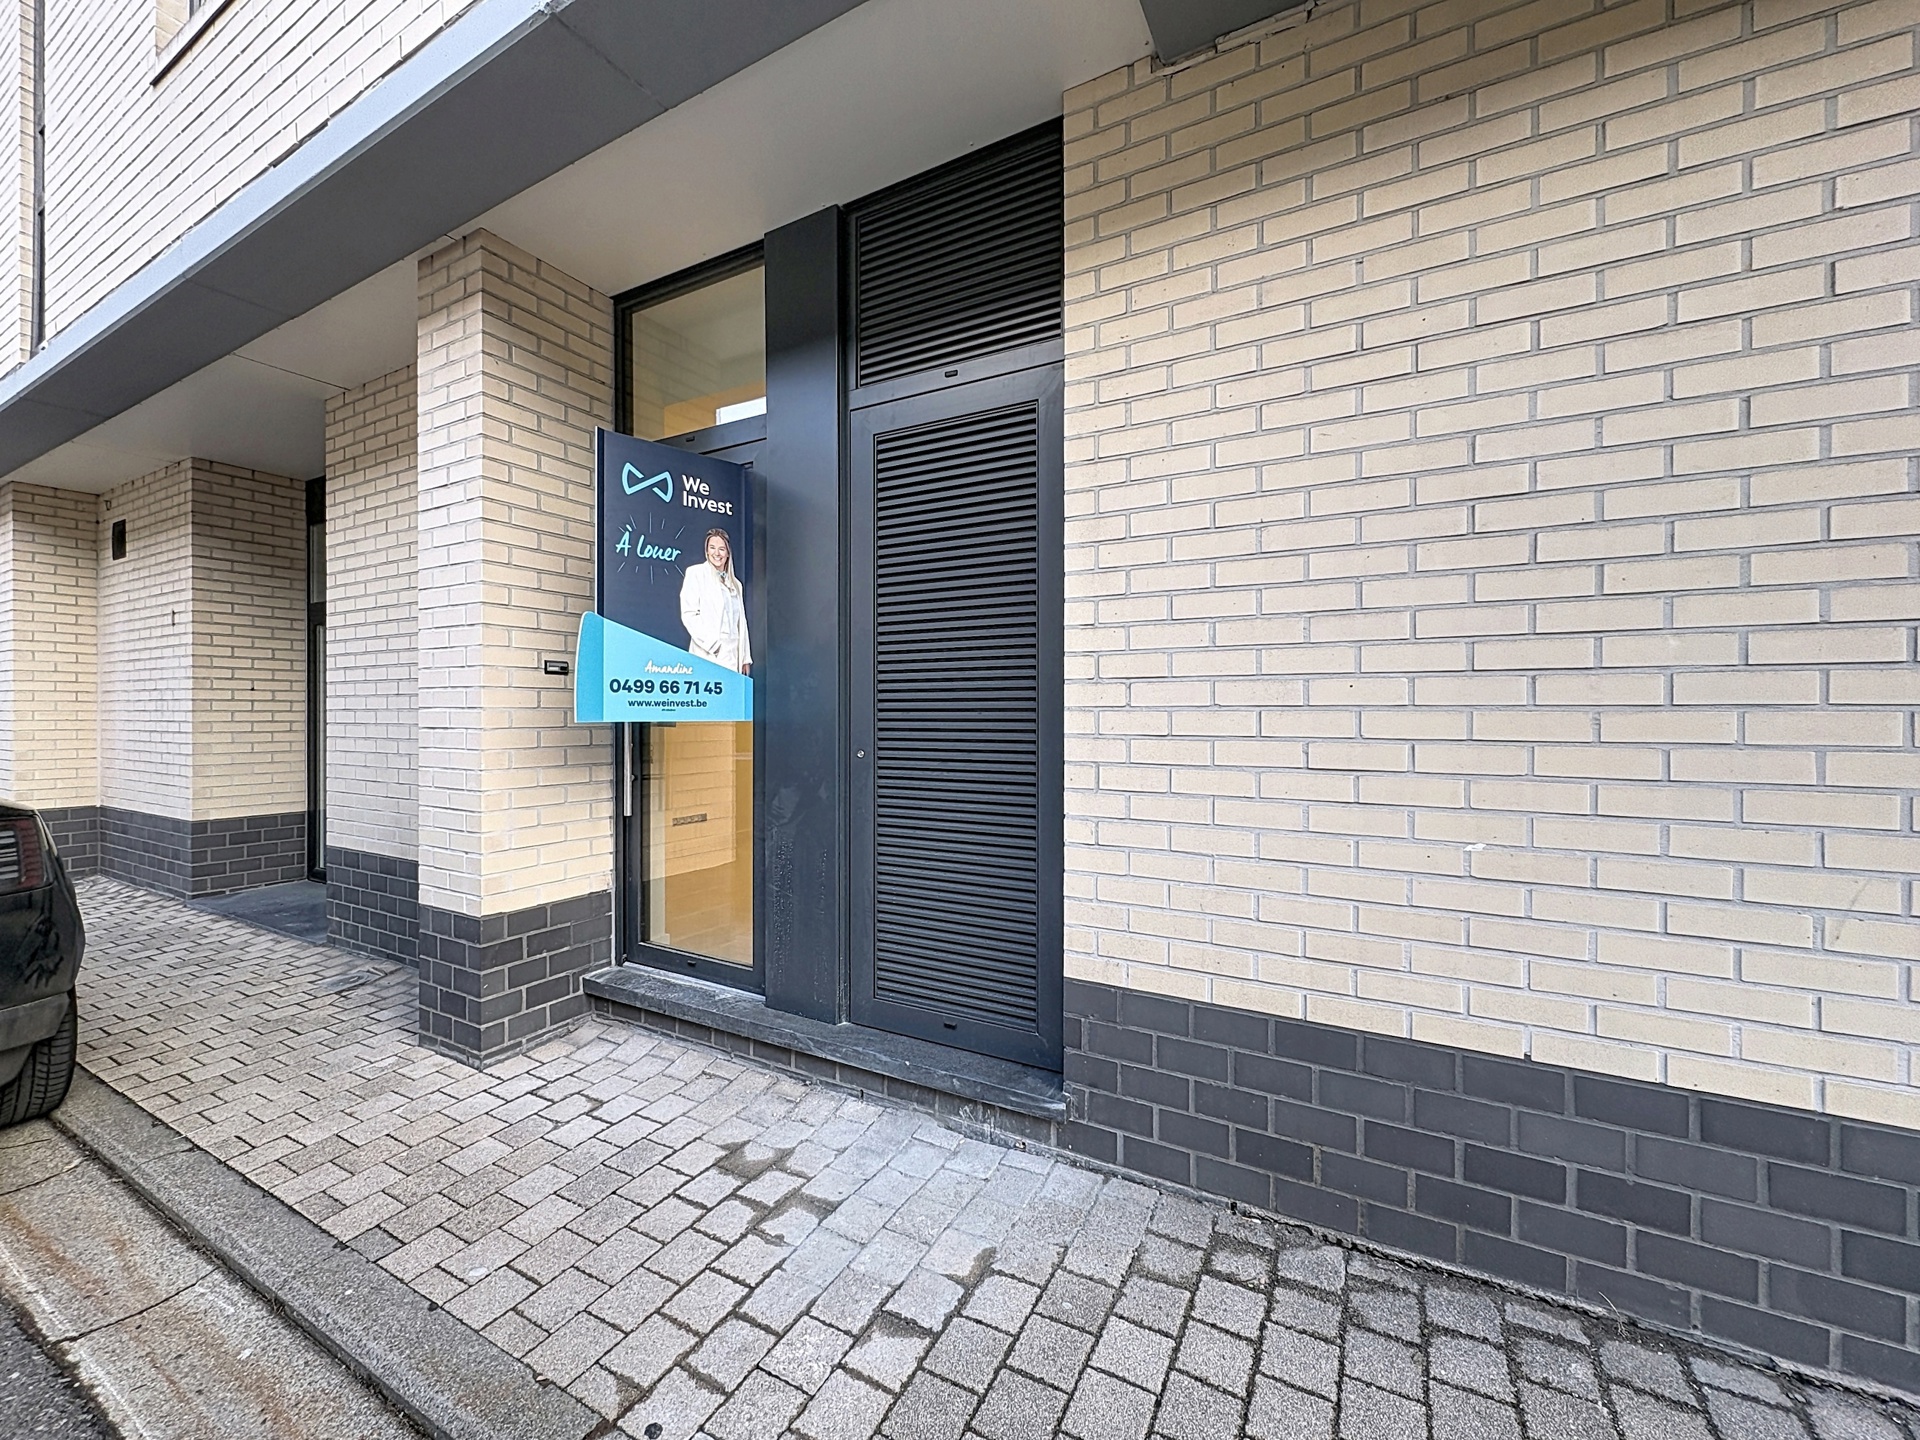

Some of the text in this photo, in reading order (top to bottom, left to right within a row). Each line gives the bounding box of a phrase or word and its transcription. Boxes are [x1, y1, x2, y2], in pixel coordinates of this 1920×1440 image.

[681, 474, 710, 496] We
[682, 490, 733, 516] Invest
[615, 524, 632, 557] À
[644, 660, 693, 675] Amandine
[609, 678, 723, 695] 0499 66 71 45
[627, 699, 707, 708] www.weinvest.be
